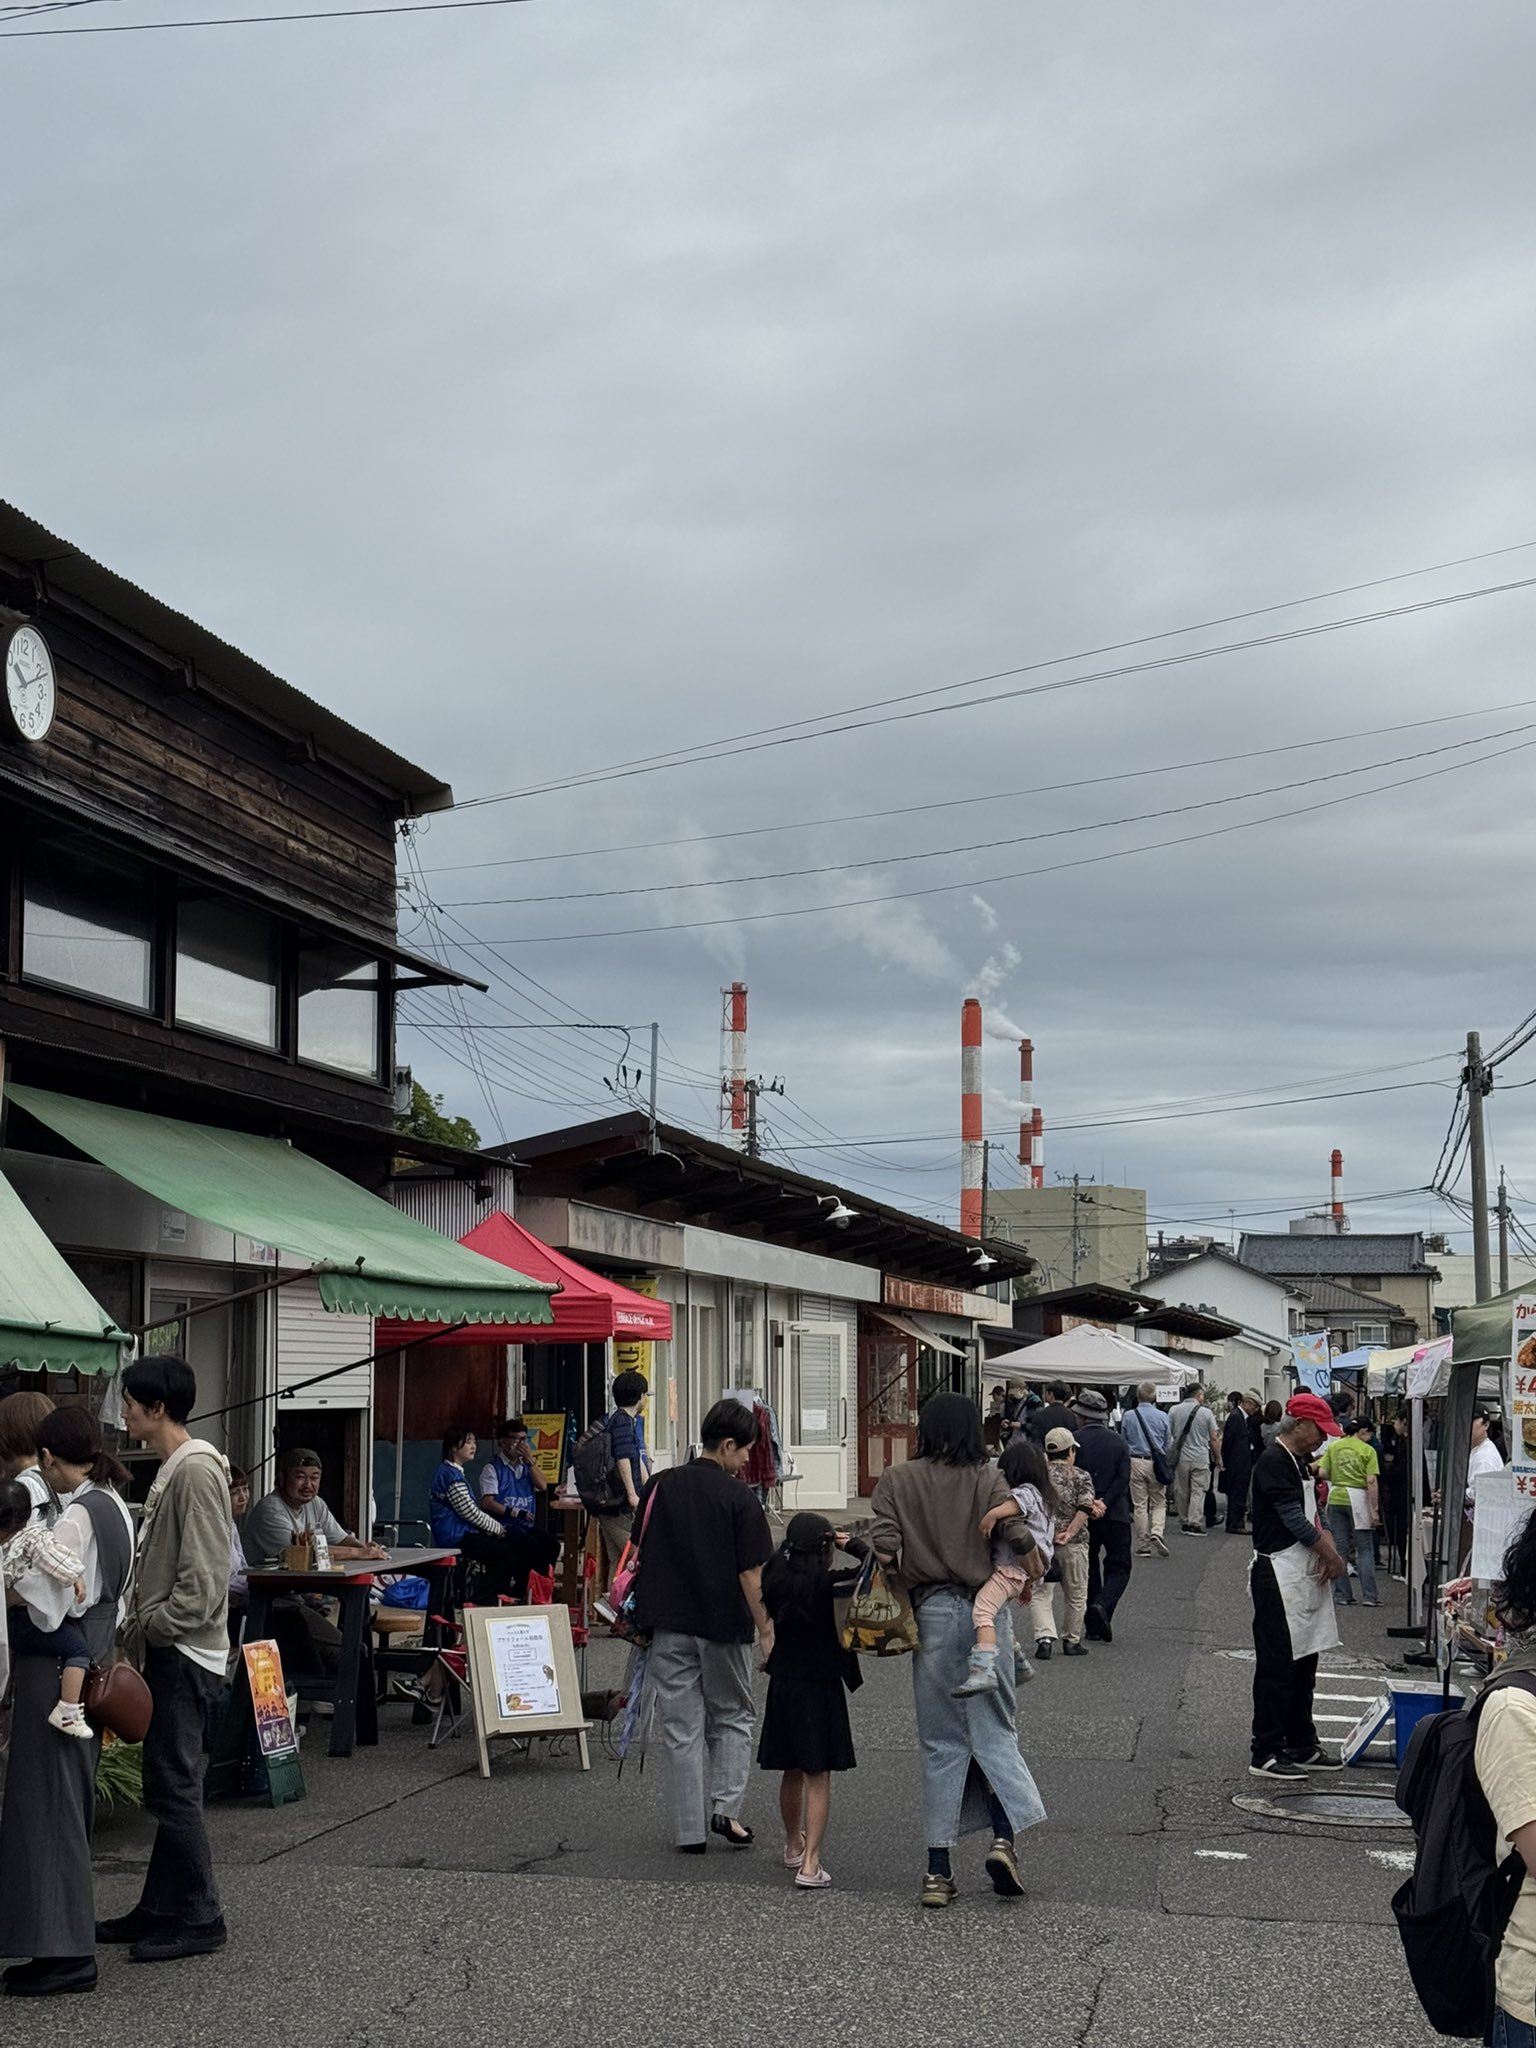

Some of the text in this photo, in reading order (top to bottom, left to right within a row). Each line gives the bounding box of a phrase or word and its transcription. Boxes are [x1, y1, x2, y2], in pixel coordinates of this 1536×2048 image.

[20, 637, 29, 656] 12
[37, 683, 44, 700] 3
[35, 702, 41, 717] 4
[20, 713, 26, 729] 6
[28, 712, 35, 729] 5
